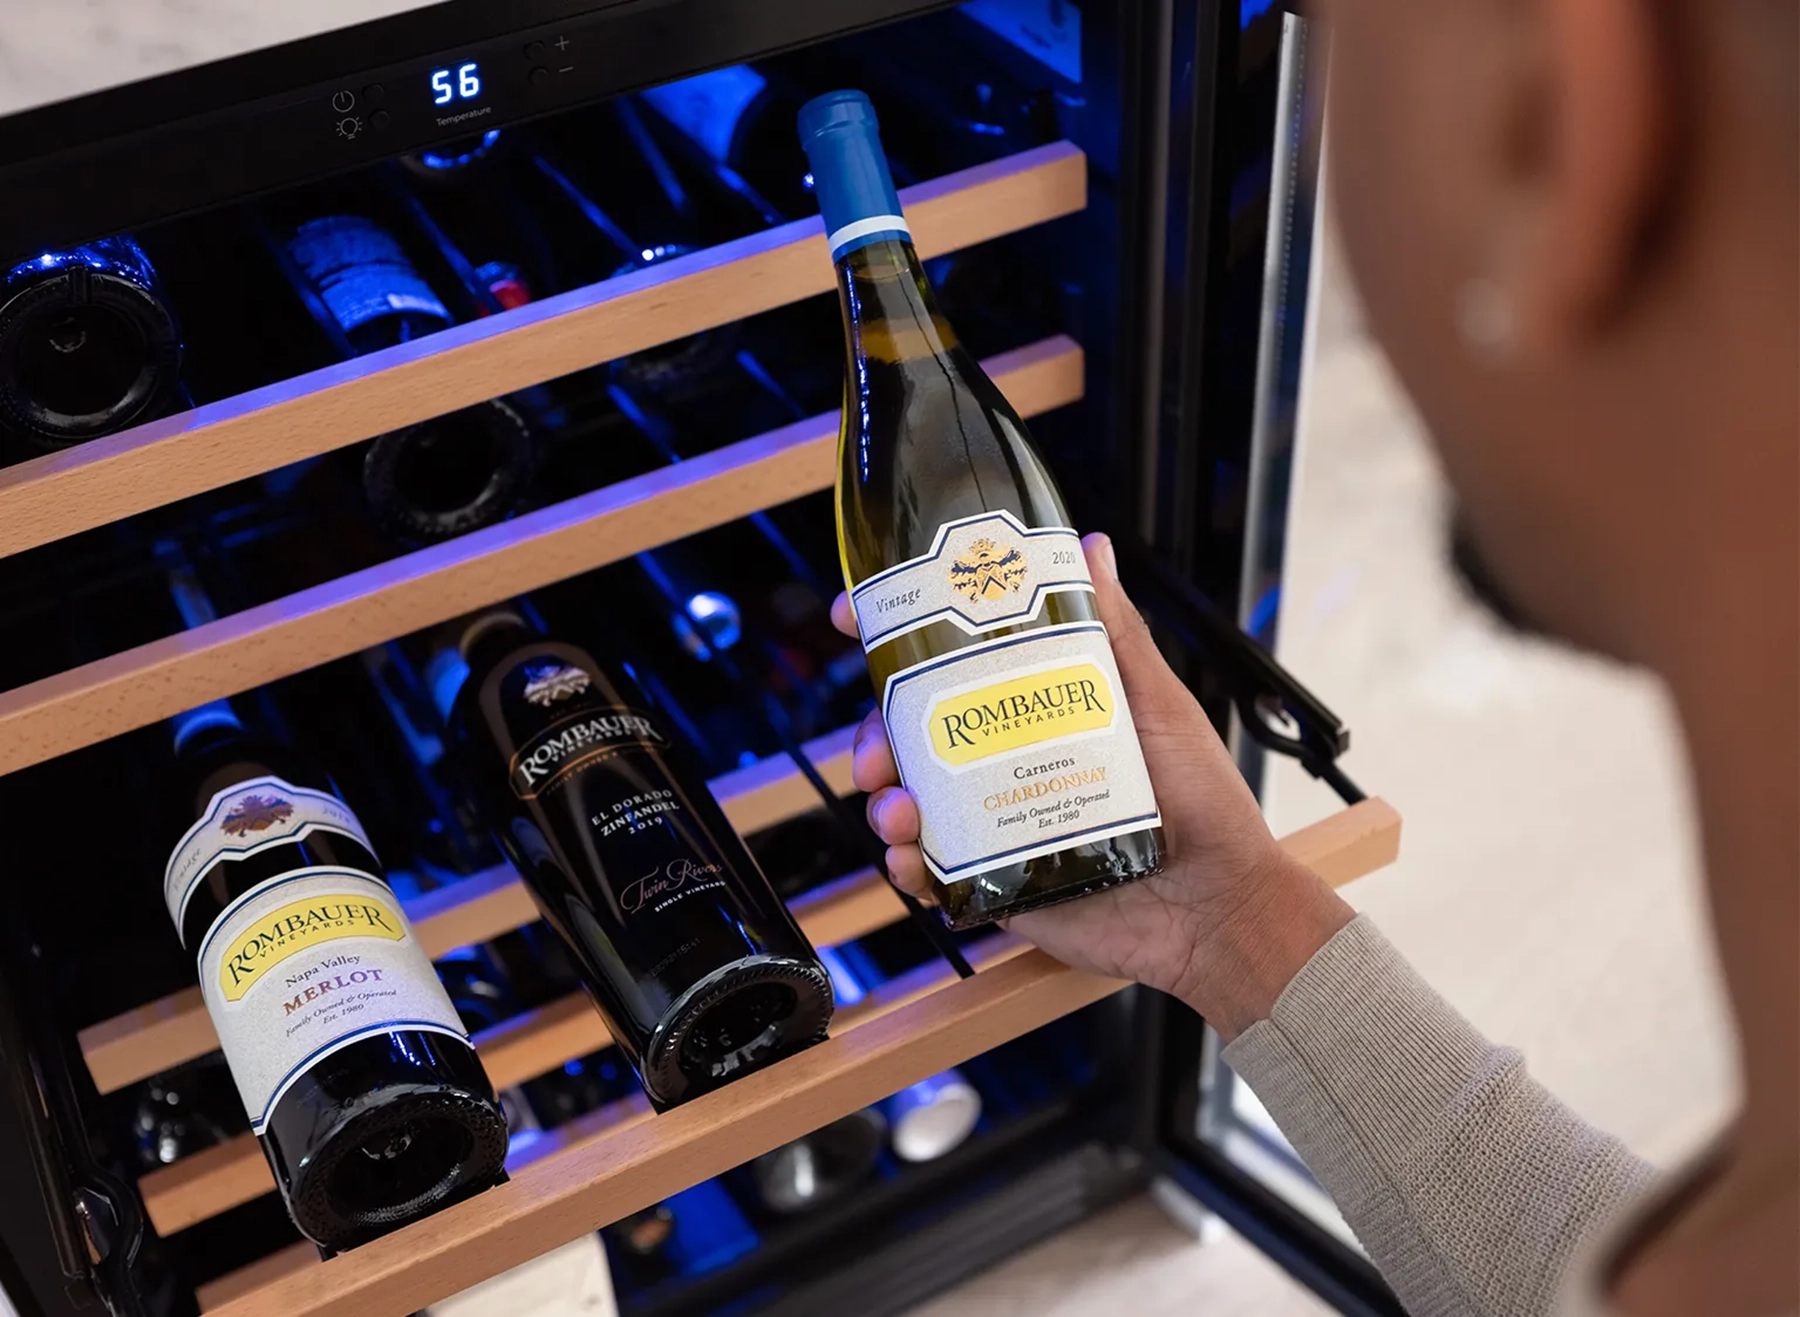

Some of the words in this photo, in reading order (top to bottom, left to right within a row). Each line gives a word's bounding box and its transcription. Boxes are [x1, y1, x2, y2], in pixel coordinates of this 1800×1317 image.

[432, 63, 480, 105] 56
[436, 106, 492, 126] Temperature
[876, 587, 921, 613] Vintage
[941, 679, 1107, 749] ROMBAUER
[982, 706, 1076, 737] VINEYARDS
[519, 715, 664, 787] ROMBAUER
[1013, 756, 1076, 780] Carneros
[983, 766, 1108, 811] CHARDONNAY
[591, 811, 609, 826] EL
[612, 789, 673, 813] DORADO
[601, 801, 680, 837] ZINFANDEL
[628, 816, 663, 835] 2019
[997, 811, 1028, 828] Family
[1029, 801, 1061, 818] Owned
[1062, 799, 1073, 809] &
[1074, 789, 1110, 808] Operated
[1038, 815, 1055, 829] Est.
[1058, 809, 1080, 824] 1980
[620, 866, 669, 915] Twin
[665, 858, 723, 891] Rivers
[654, 893, 684, 913] SINGLE
[686, 880, 726, 896] VINEYARD
[227, 904, 395, 988] ROMBAUER
[259, 919, 355, 958] VINEYARDS
[285, 967, 319, 988] Napa
[321, 955, 361, 970] Valley
[283, 969, 383, 1017] MERLOT
[285, 1013, 312, 1038] Family
[313, 998, 344, 1017] Owned
[357, 989, 397, 1003] Operated
[323, 1012, 339, 1025] Est.
[342, 1003, 364, 1016] 1980
